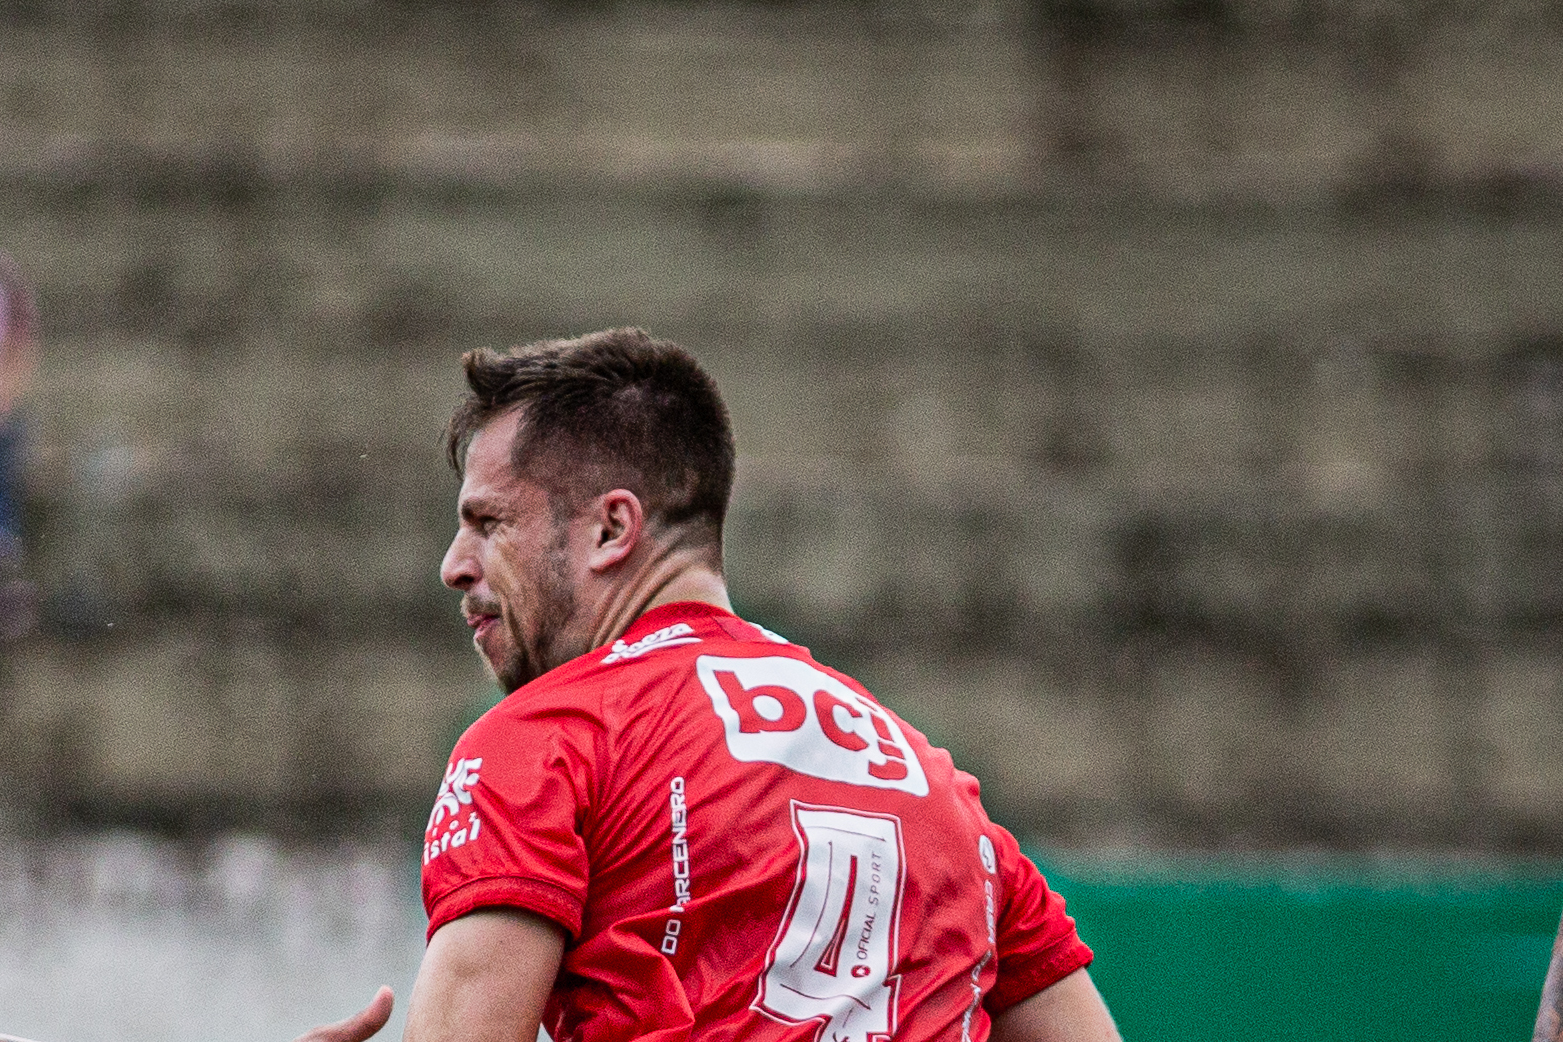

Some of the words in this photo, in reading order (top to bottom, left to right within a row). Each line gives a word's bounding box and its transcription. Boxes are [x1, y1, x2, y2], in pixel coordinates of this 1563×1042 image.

[661, 919, 681, 955] DO
[856, 914, 876, 960] OFICIAL
[867, 851, 883, 906] SPORT
